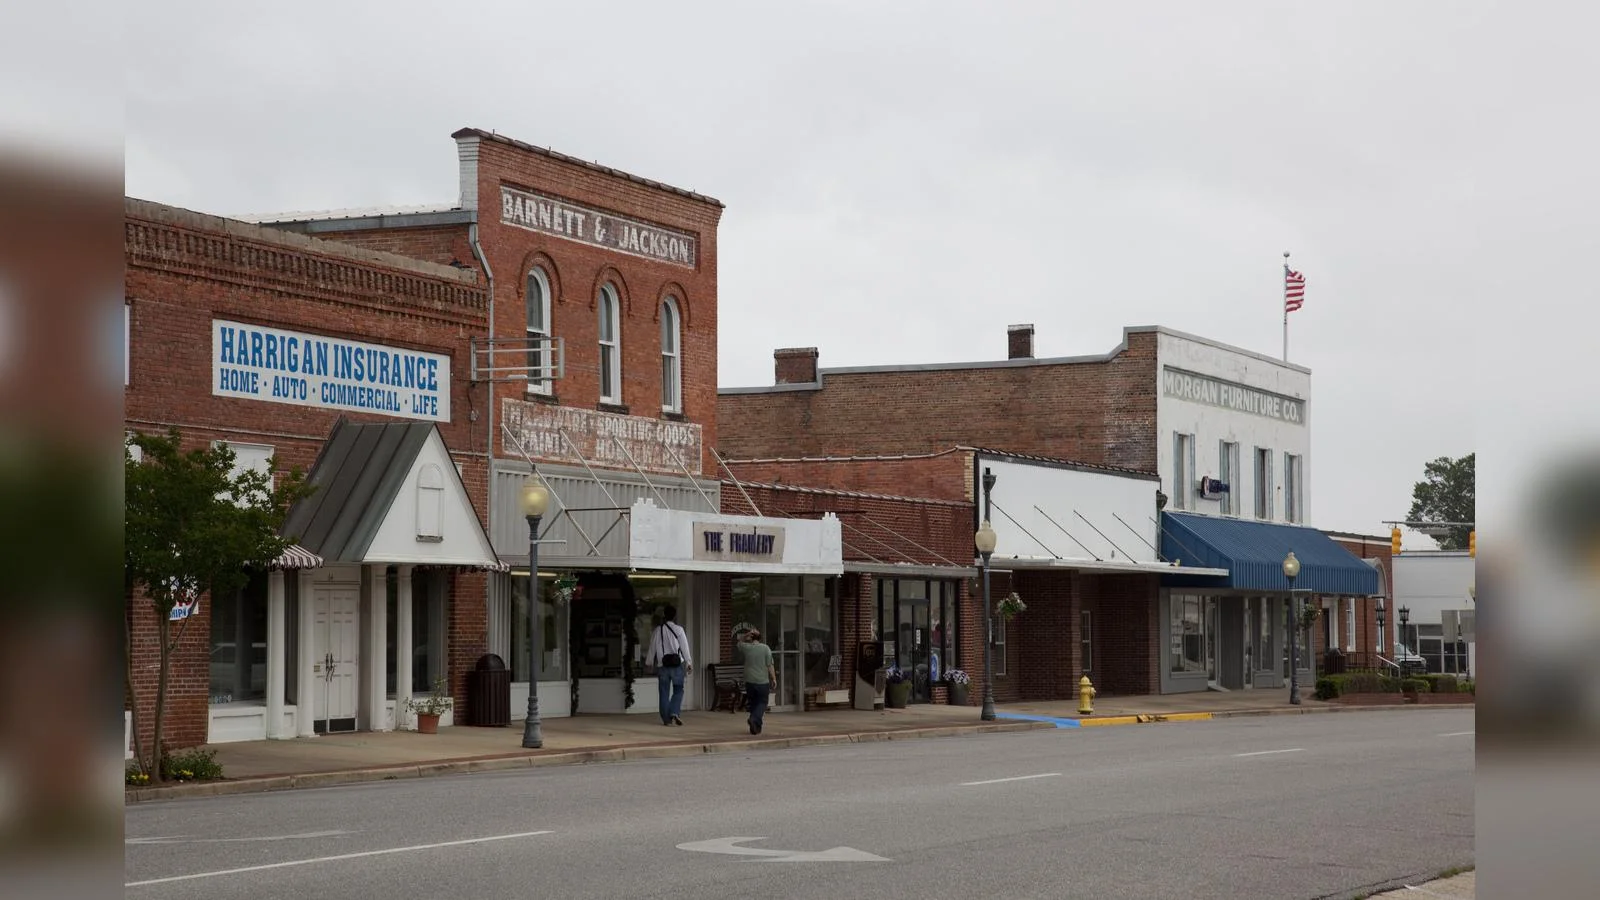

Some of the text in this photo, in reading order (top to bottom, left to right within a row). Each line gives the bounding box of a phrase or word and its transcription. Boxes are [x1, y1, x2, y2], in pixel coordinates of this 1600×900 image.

[503, 193, 689, 262] BARNETT & JACKSON
[220, 326, 438, 391] HARRIGAN INSURANCE
[220, 368, 438, 416] HOME AUTO COMMERCIAL LIFE
[1163, 371, 1299, 422] MORGAN FURNITURE CO.
[597, 416, 651, 441] SPORTING
[656, 423, 695, 447] GOODS
[704, 531, 776, 554] THE FRAMERY
